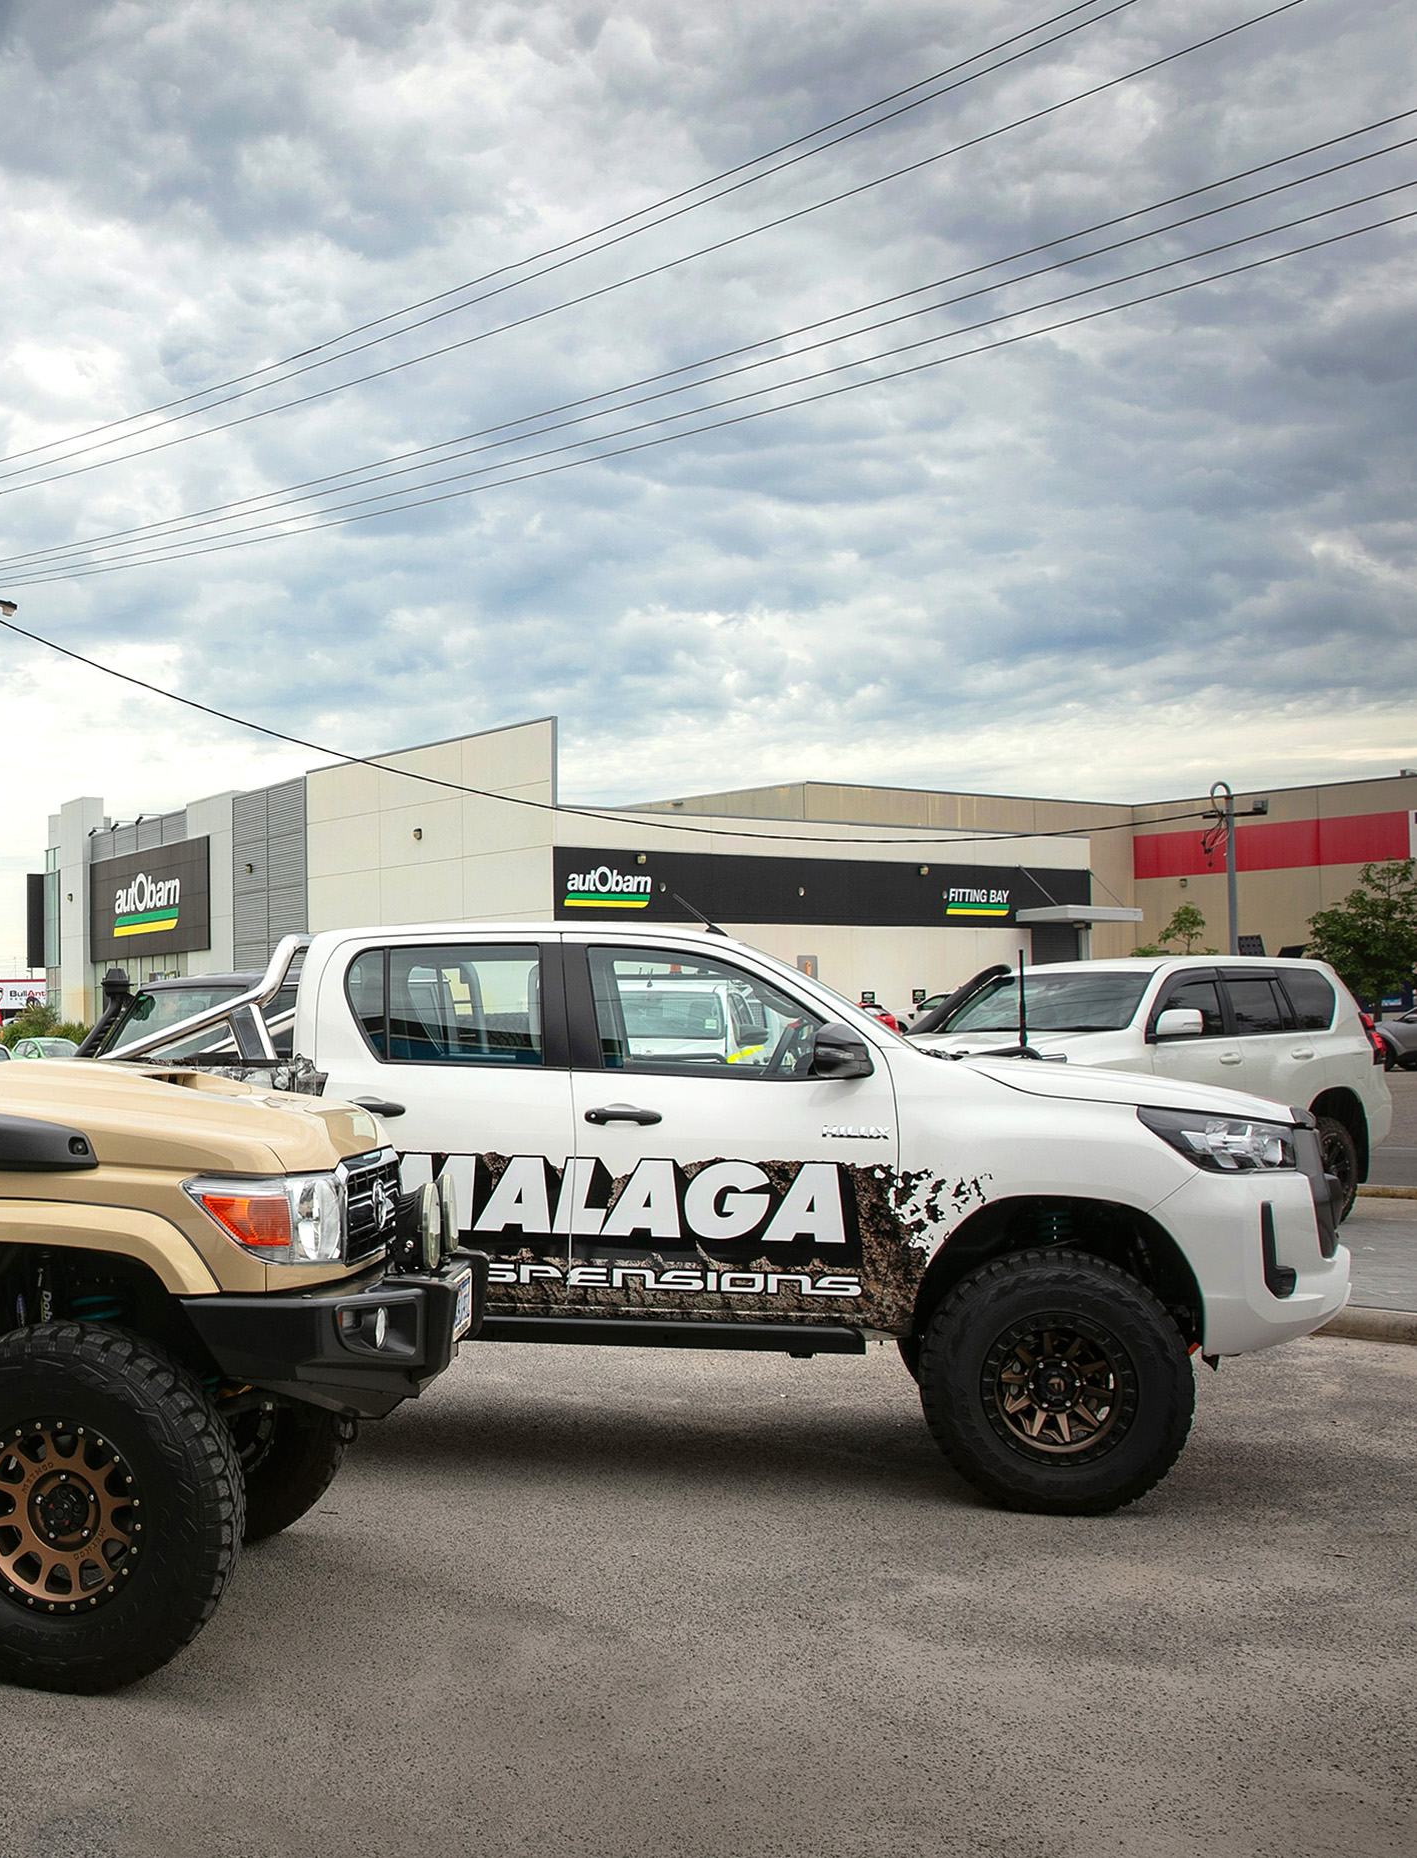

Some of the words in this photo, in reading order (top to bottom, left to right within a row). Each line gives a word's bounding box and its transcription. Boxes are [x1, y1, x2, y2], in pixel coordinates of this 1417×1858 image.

[949, 888, 987, 902] FITTING
[989, 890, 1010, 903] BAY
[10, 990, 46, 998] BullAnt
[822, 1123, 890, 1140] HILUX
[22, 1462, 54, 1494] METHOD
